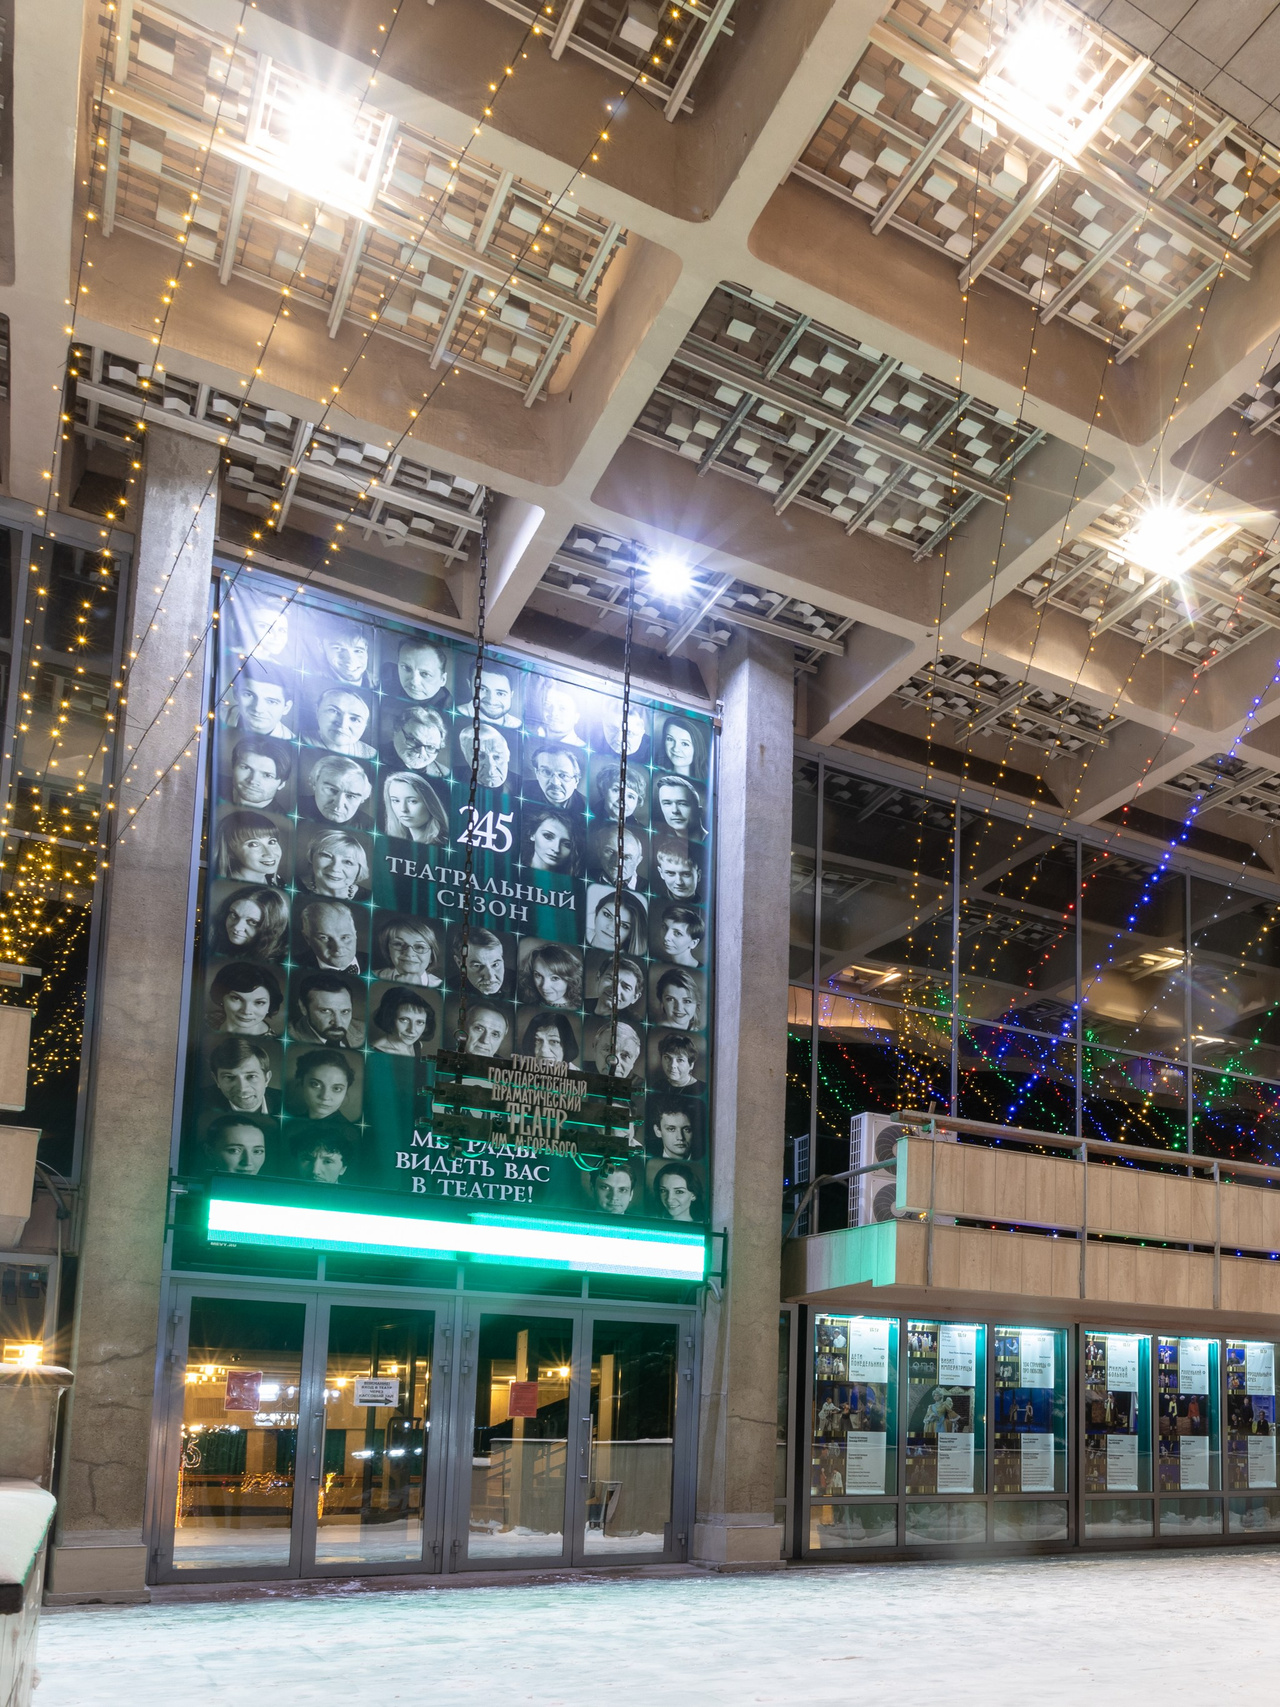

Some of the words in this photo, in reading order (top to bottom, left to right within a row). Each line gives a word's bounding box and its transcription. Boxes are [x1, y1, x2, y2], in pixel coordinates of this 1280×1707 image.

[456, 805, 515, 854] 245
[385, 855, 576, 911] ТЕАТРАЛЬНЫЙ
[511, 1053, 569, 1078] ТУЛЬСКИЙ
[488, 1066, 588, 1098] ГОСУДАРСТВЕННЫЙ
[491, 1084, 582, 1112] ДРАМАТИЧЕСКИЙ
[506, 1101, 568, 1139] ТЕАТР
[395, 1151, 496, 1178] ВИДЕТЬ
[504, 1162, 551, 1183] ВАС
[411, 1176, 427, 1194] В
[437, 1178, 534, 1204] ТЕАТРЕ!
